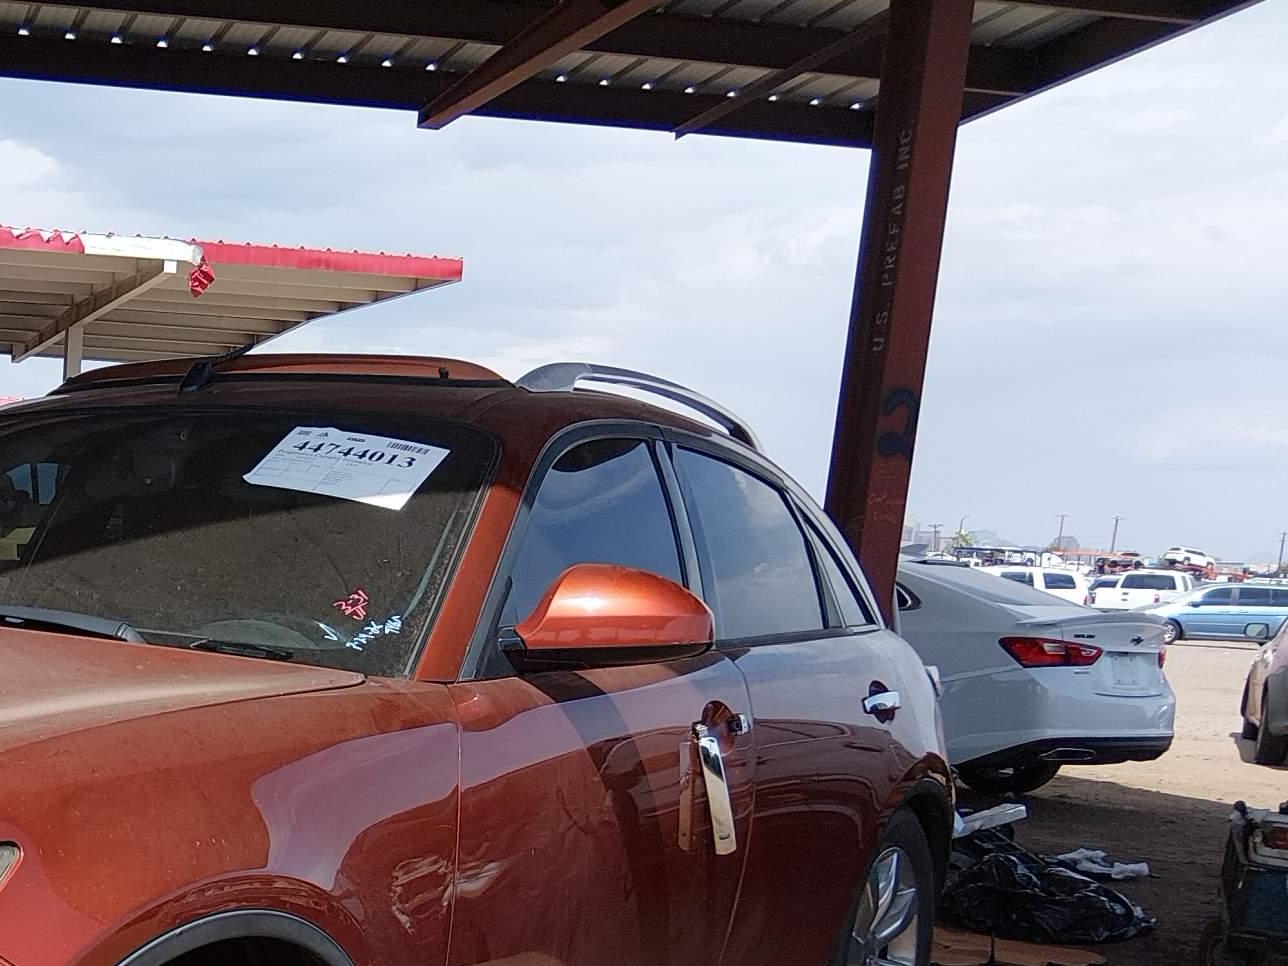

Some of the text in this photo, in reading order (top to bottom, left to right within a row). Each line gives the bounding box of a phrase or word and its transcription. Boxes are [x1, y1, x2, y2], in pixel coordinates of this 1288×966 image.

[872, 119, 916, 352] U.S. PREFAB INC.
[293, 440, 416, 469] 44744013
